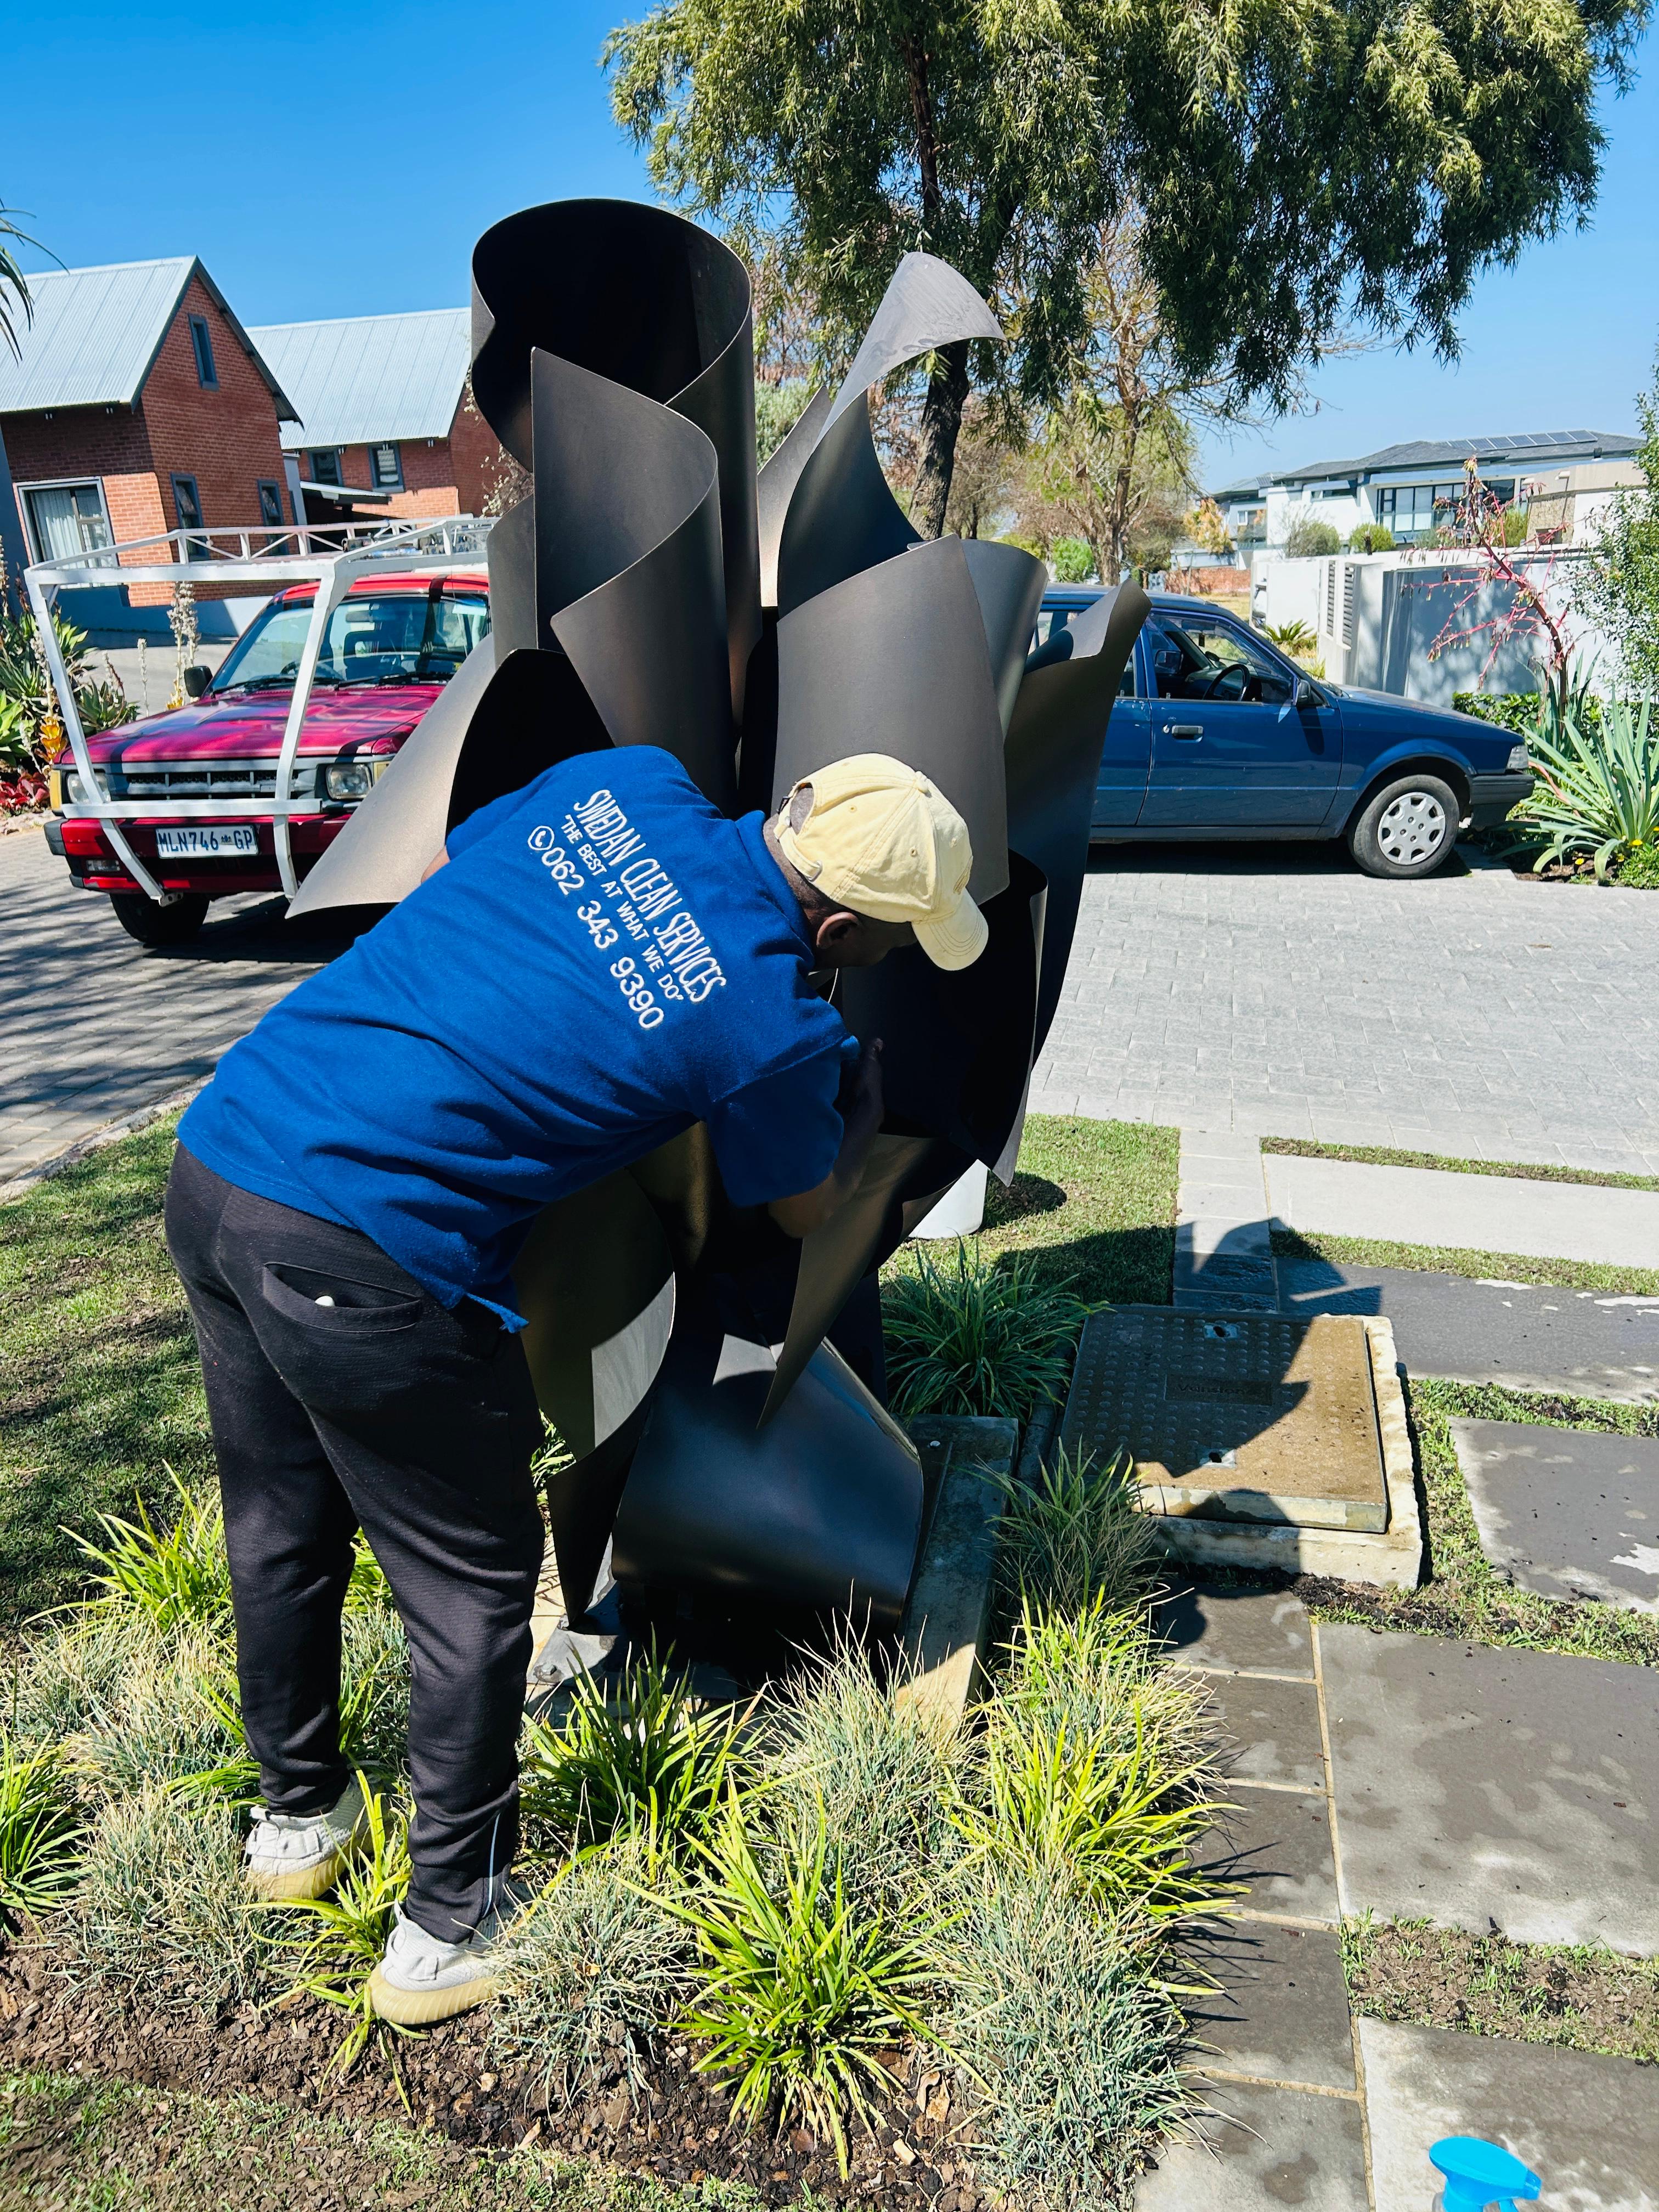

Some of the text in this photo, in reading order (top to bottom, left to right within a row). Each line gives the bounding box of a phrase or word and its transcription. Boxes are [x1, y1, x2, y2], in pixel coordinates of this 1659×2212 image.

[158, 830, 252, 851] MLN746 GP
[573, 789, 727, 1003] SWEDAN CLEAN SERVICES
[577, 843, 607, 876] BEST
[600, 881, 623, 898] AT
[616, 900, 650, 941] WHAT
[641, 944, 664, 973] WE
[541, 847, 664, 1029] 062 343 9390
